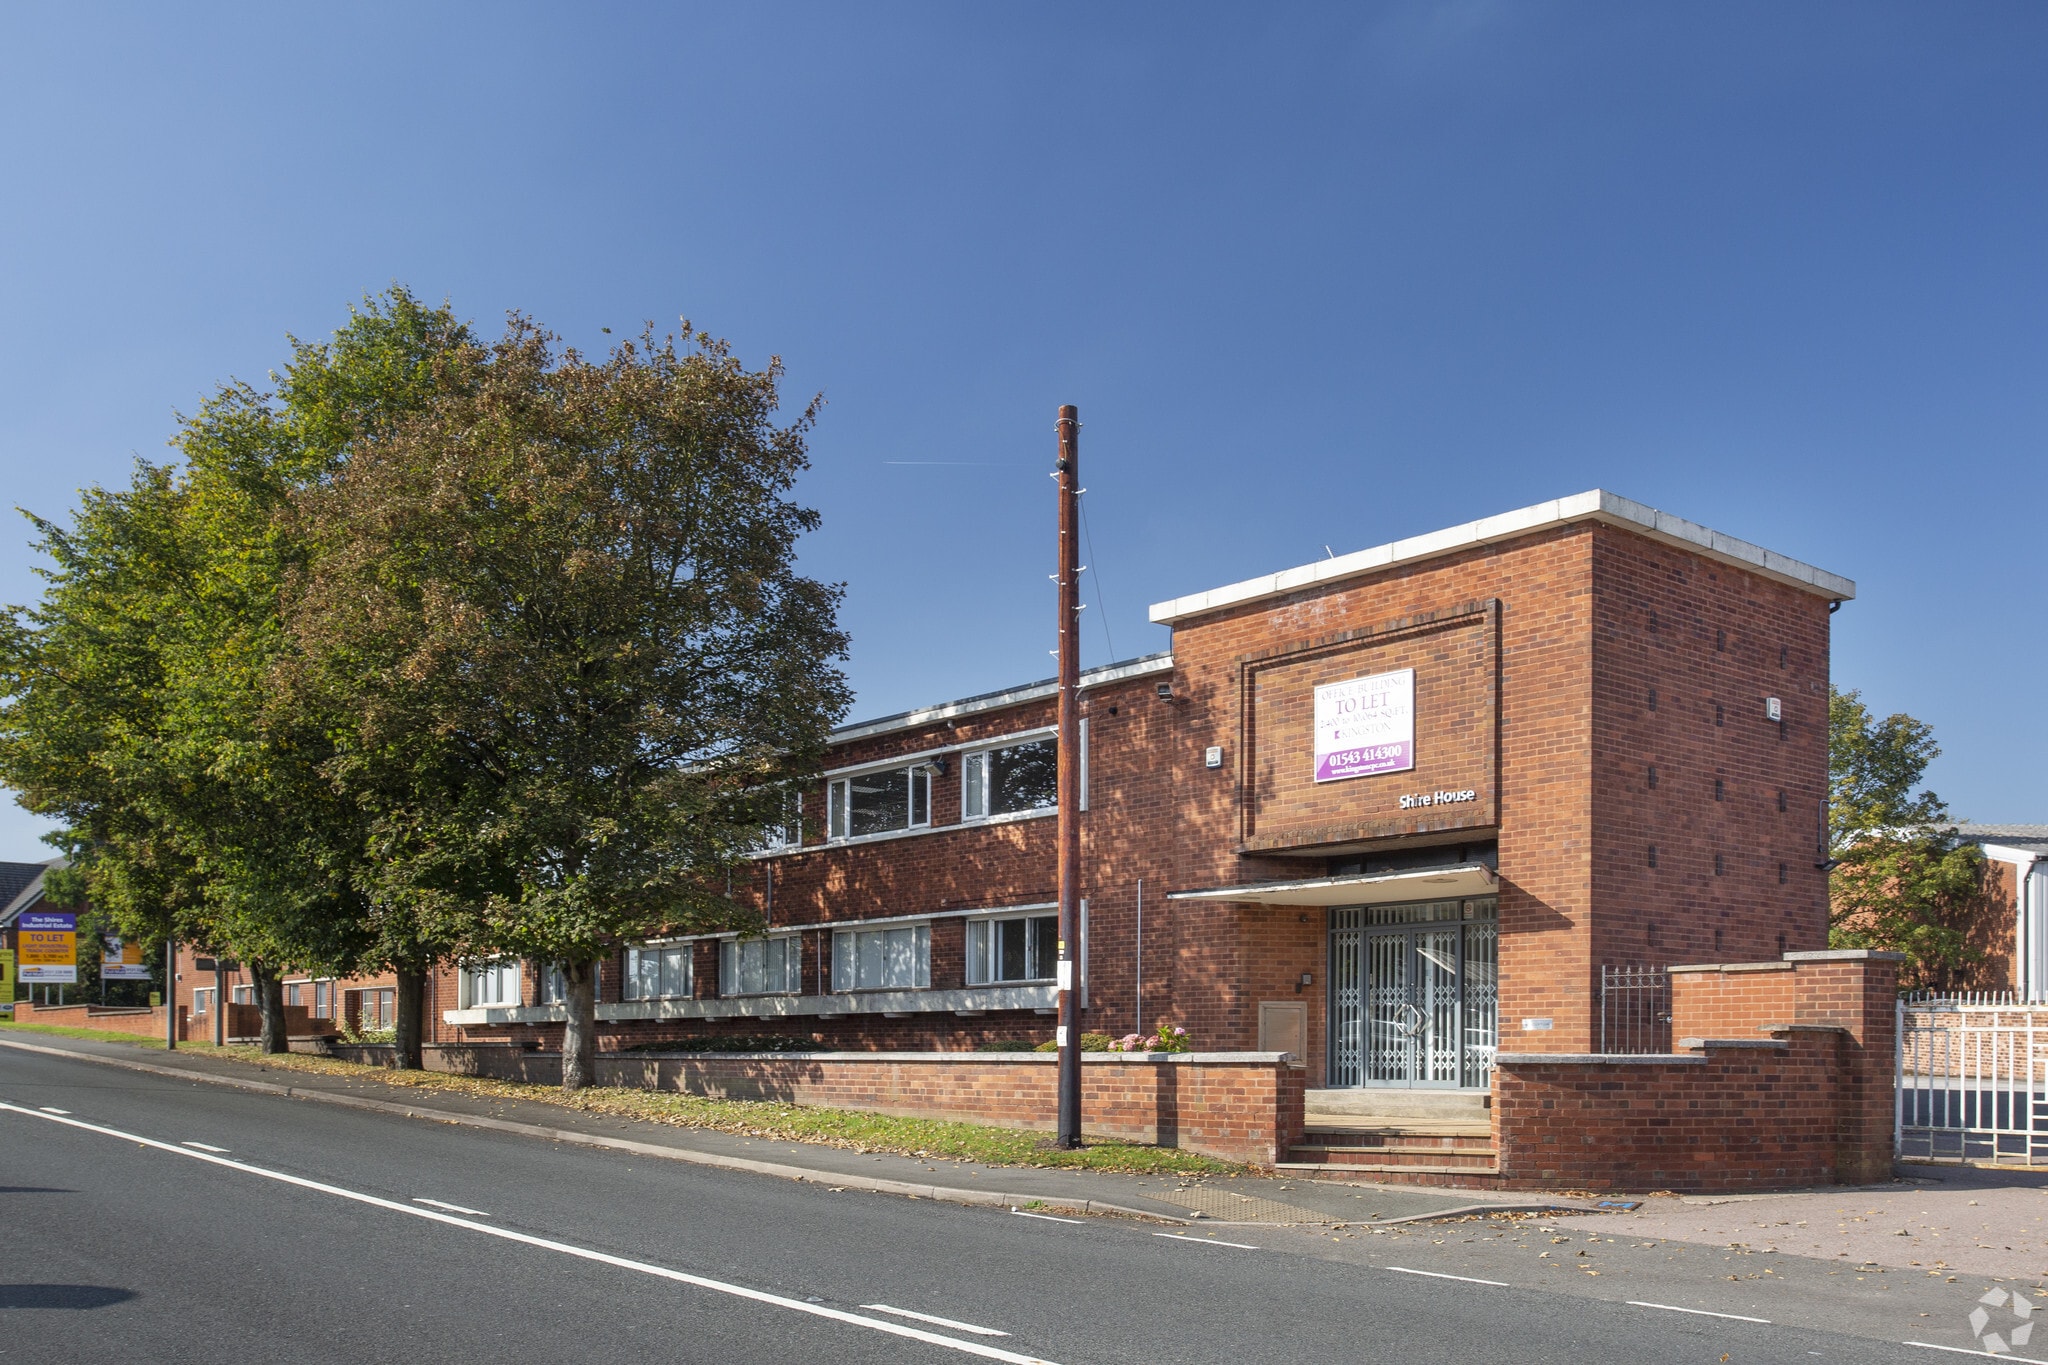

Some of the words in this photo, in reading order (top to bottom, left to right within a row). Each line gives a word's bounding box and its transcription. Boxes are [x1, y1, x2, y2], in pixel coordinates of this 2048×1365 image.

[1321, 686, 1353, 700] OFFICE
[1358, 675, 1406, 693] BUILDING
[1335, 697, 1357, 715] TO
[1361, 691, 1390, 710] LET
[1341, 721, 1391, 739] KINGSTON
[1329, 751, 1360, 767] 01543
[1362, 744, 1402, 762] 414300
[1399, 793, 1431, 810] Shire
[1434, 789, 1476, 805] House
[30, 933, 44, 942] TO
[47, 933, 64, 942] LET
